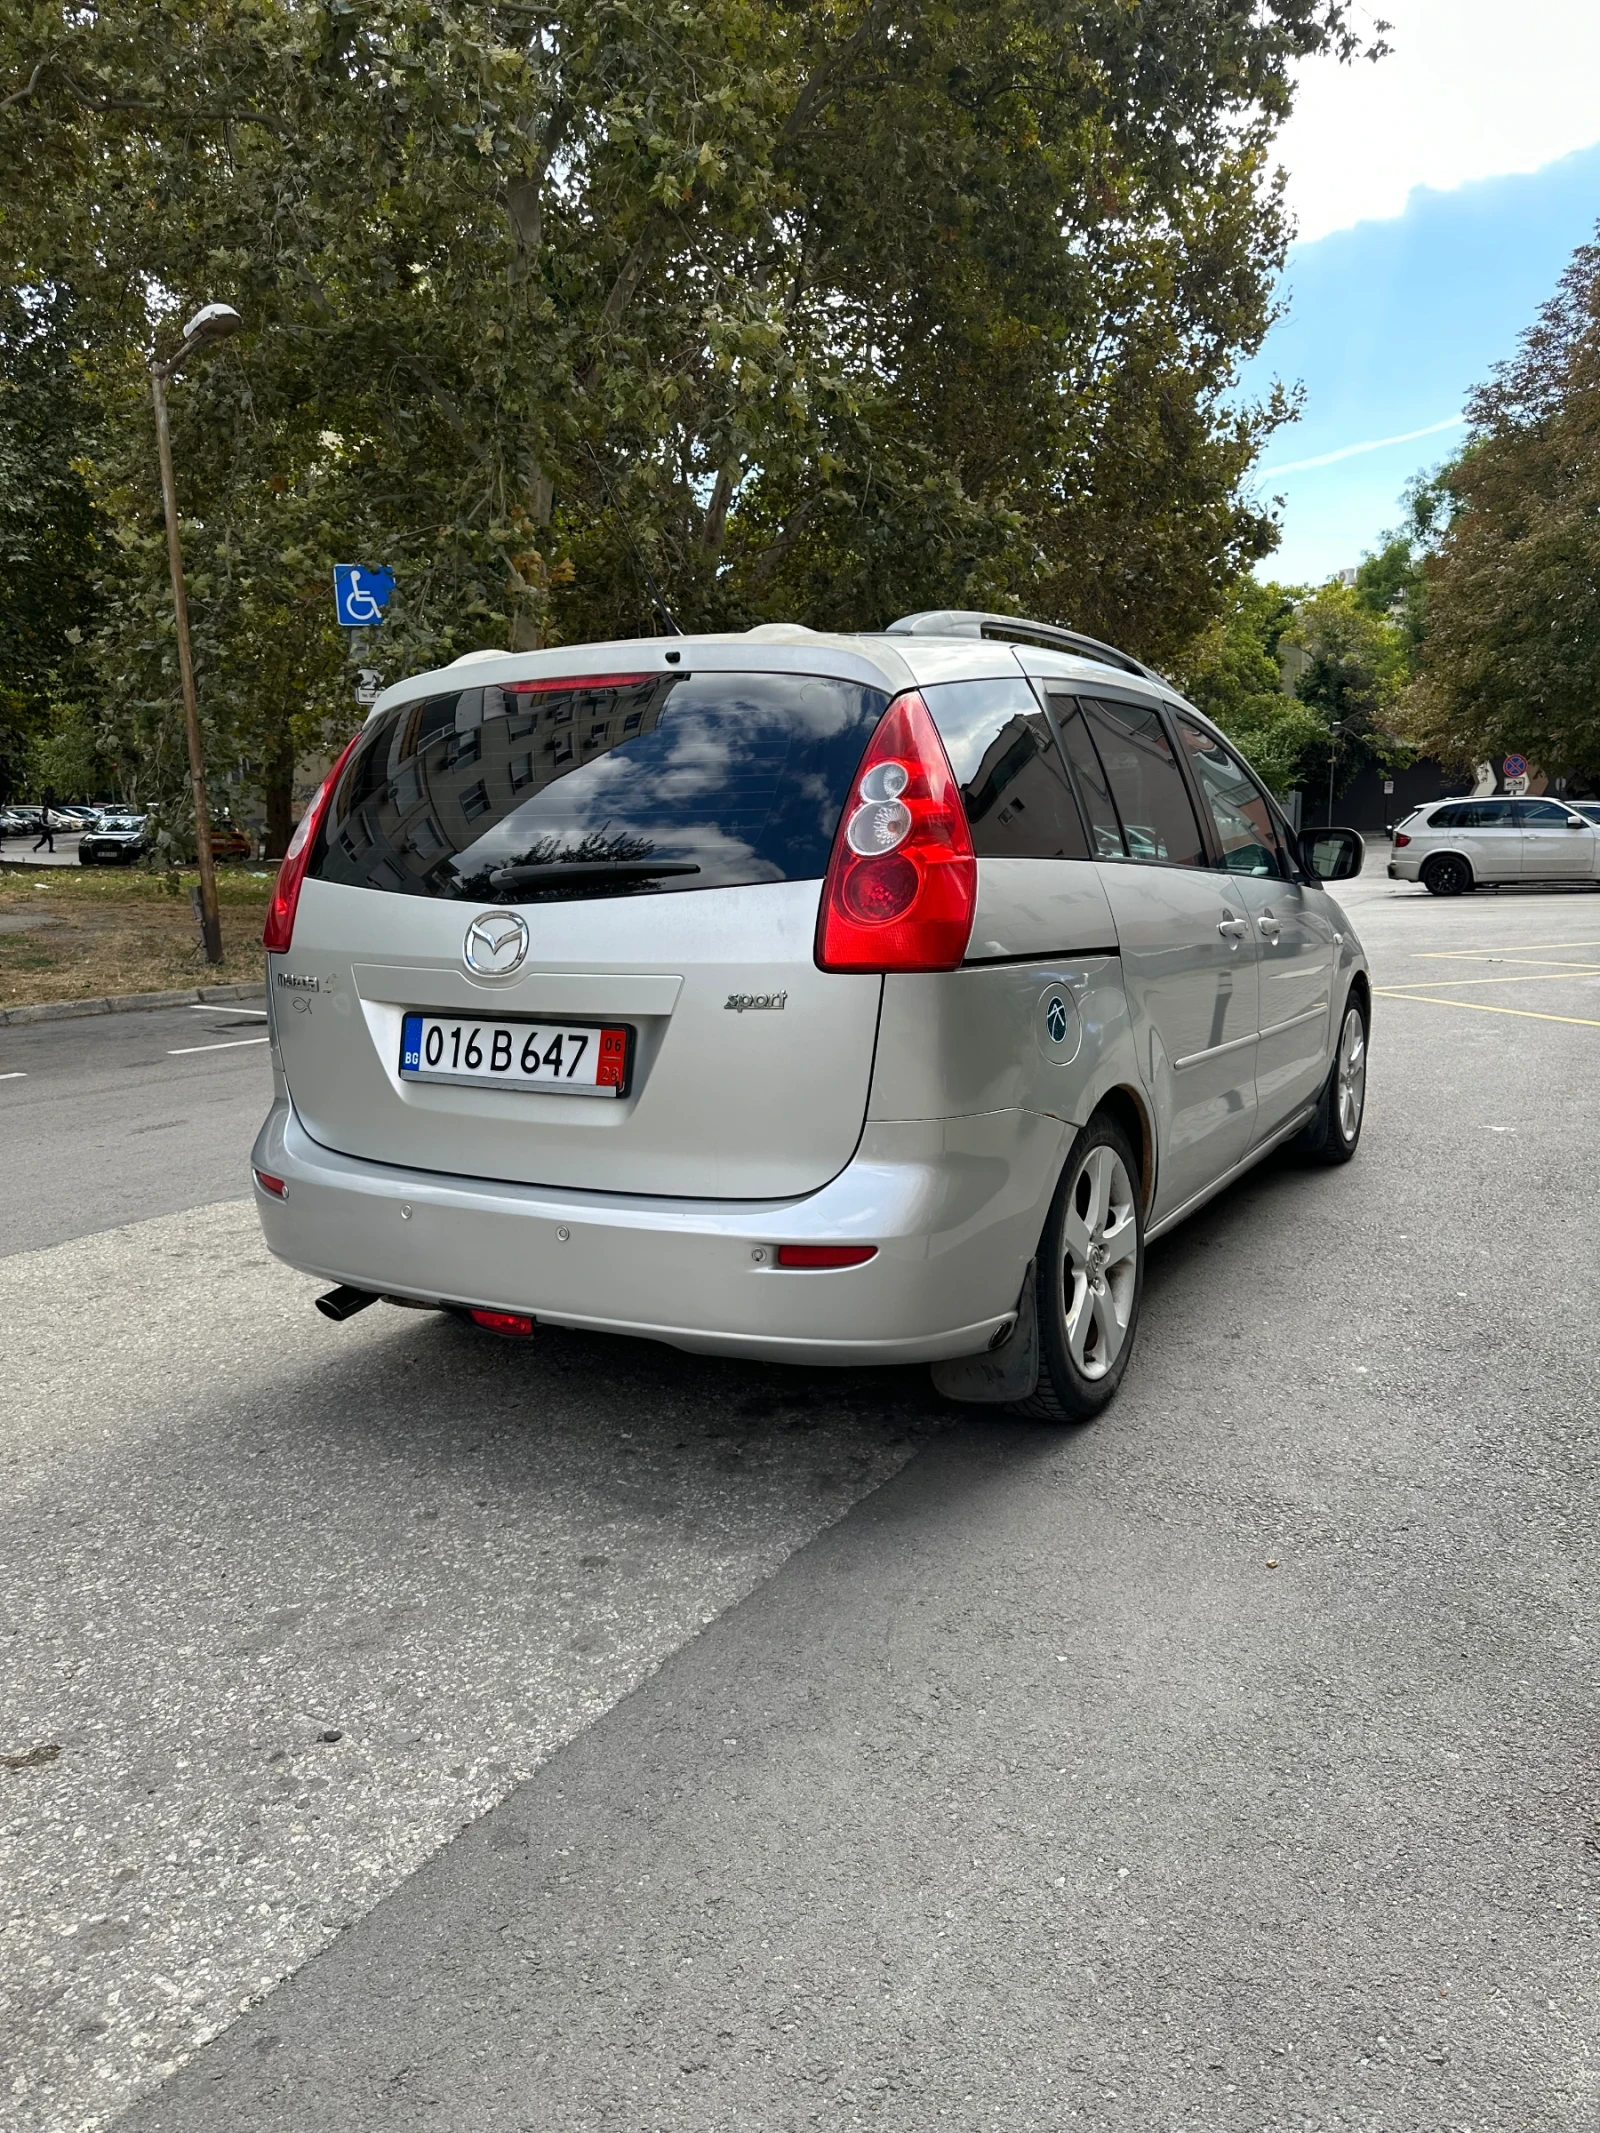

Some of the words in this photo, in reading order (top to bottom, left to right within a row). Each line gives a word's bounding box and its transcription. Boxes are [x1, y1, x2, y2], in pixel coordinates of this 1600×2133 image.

[724, 989, 788, 1013] sport
[605, 1037, 622, 1052] 06
[404, 1051, 420, 1065] BG
